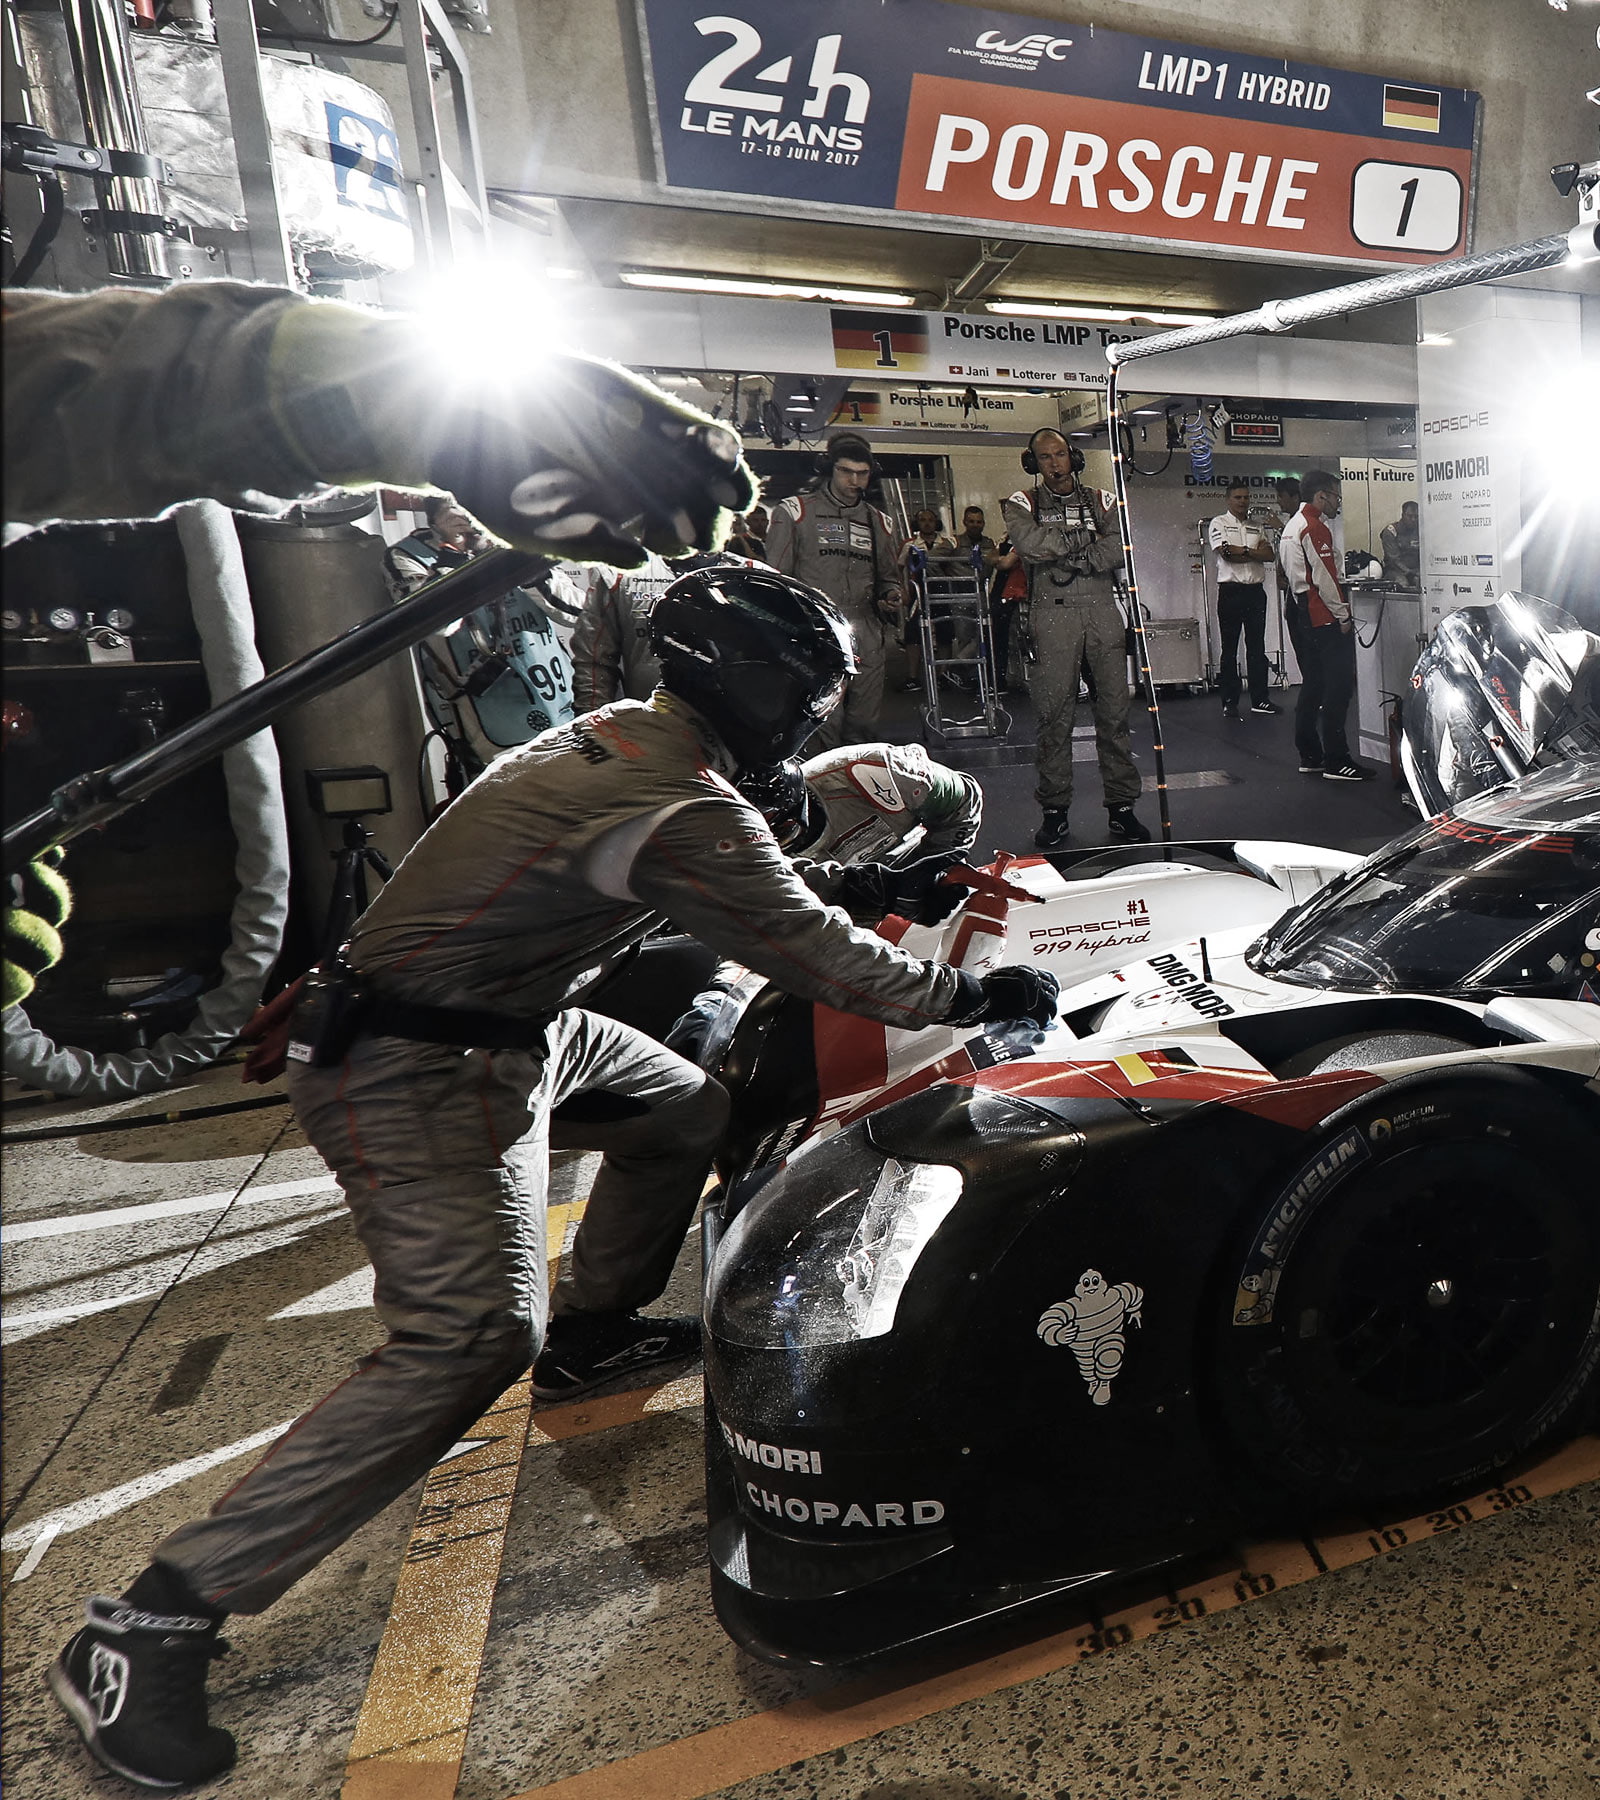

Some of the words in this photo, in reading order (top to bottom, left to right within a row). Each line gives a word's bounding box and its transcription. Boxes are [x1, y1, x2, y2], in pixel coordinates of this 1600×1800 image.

[684, 15, 870, 124] 24h
[963, 49, 989, 59] WORLD
[990, 53, 1040, 66] ENDURANCE
[980, 58, 1037, 71] CHAMPIONSHIP
[1137, 51, 1226, 101] LMP1
[1236, 72, 1331, 111] HYBRID
[681, 107, 734, 135] LE
[742, 114, 863, 151] MANS
[741, 141, 782, 158] 17-18
[787, 146, 820, 162] JUIN
[825, 150, 860, 166] 2017
[925, 114, 1319, 230] PORSCHE
[1396, 178, 1420, 237] 1
[944, 317, 1035, 343] Porsche
[1043, 324, 1091, 345] LMP
[874, 330, 898, 367] 1
[966, 367, 990, 377] Jani
[1013, 369, 1056, 381] Lotterer
[1079, 373, 1109, 385] Tandy
[850, 401, 863, 422] 1
[889, 393, 943, 408] Porsche
[981, 397, 1014, 410] Team
[929, 421, 956, 429] Lotterer
[1423, 411, 1489, 435] PORSCHE
[1373, 469, 1414, 483] Future
[1426, 460, 1453, 482] DMG
[1455, 456, 1489, 479] MORI
[1197, 491, 1228, 499] vodafon
[1462, 489, 1491, 500] CHOPARD
[1127, 899, 1149, 915] #1
[1029, 916, 1151, 939] PORSCHE
[1033, 940, 1072, 956] 919
[1075, 930, 1151, 956] hybrid
[1146, 953, 1198, 987] DMG
[1176, 982, 1236, 1020] MOR
[1259, 1136, 1359, 1260] MICHELIN
[735, 1432, 822, 1475] MORI
[746, 1481, 946, 1528] CHOPARD
[1366, 1526, 1408, 1554] 10
[1426, 1504, 1474, 1533] 20
[1485, 1484, 1534, 1512] 30
